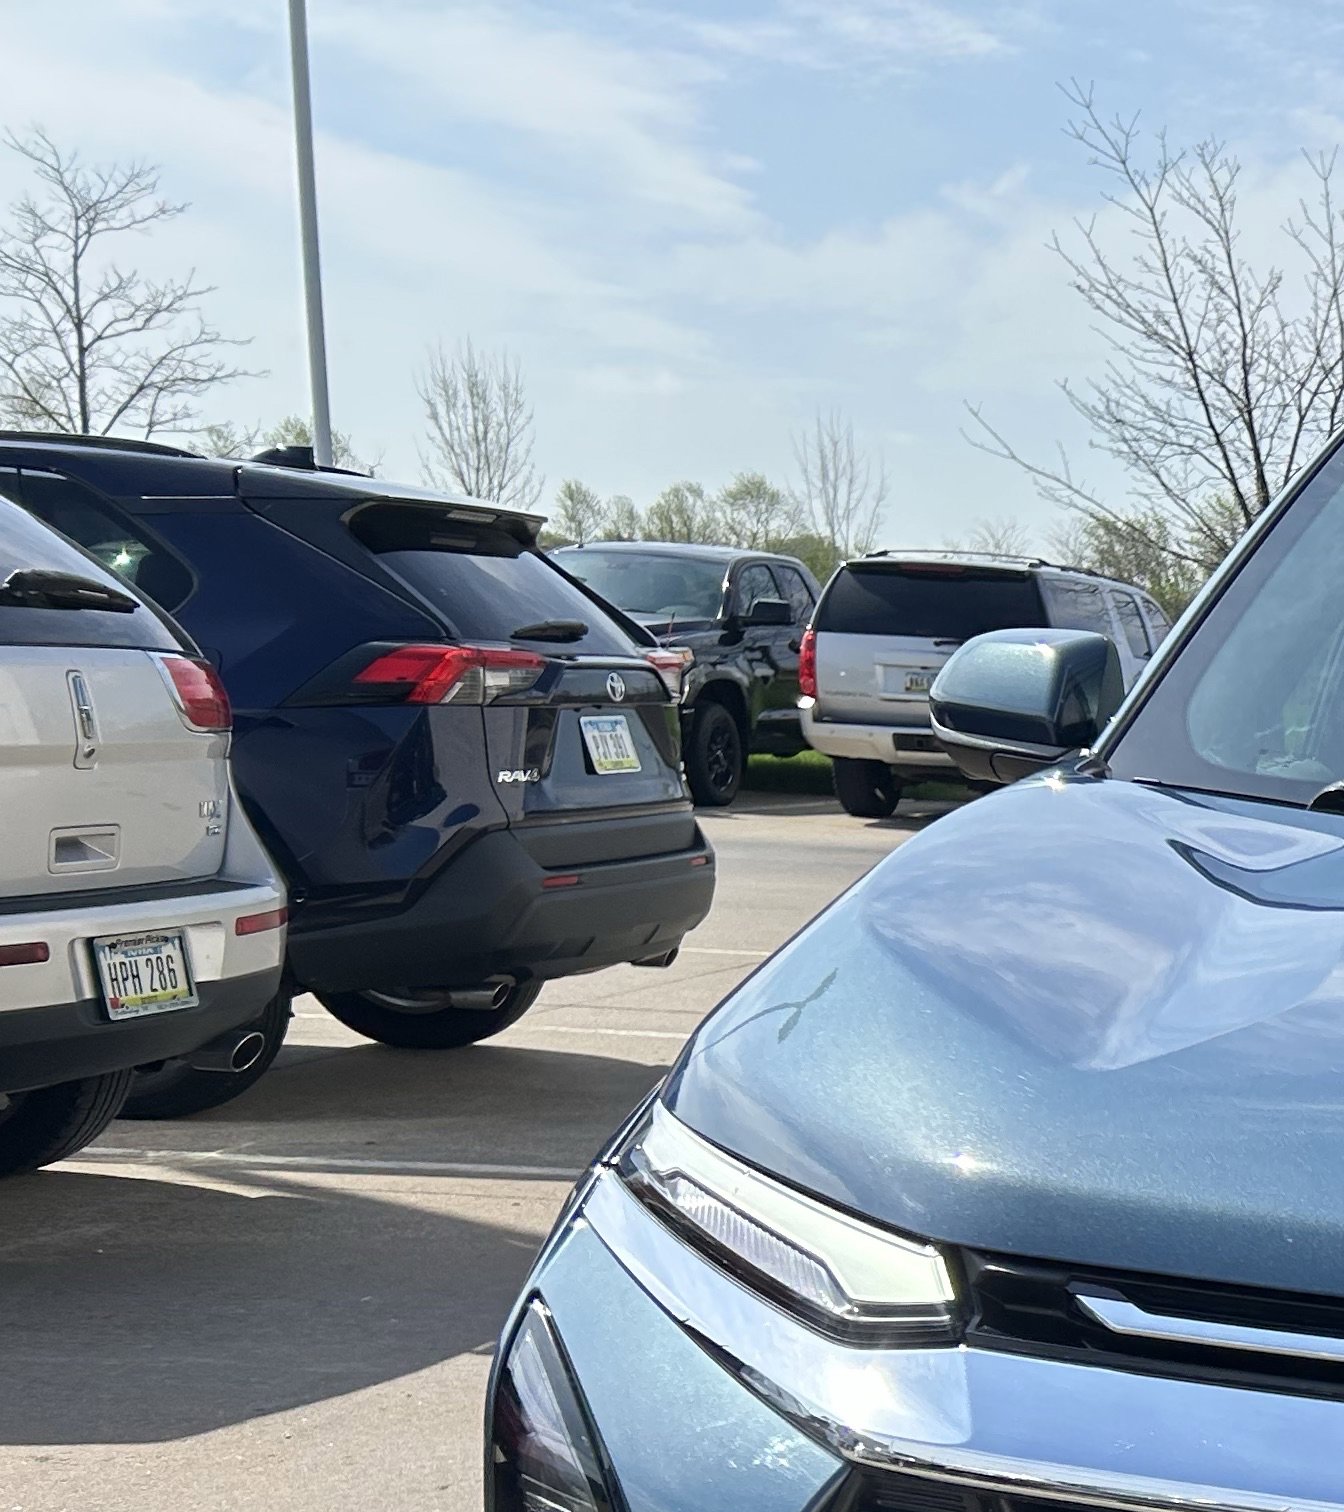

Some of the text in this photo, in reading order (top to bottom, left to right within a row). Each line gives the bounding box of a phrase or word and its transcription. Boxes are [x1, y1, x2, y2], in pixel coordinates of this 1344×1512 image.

[497, 768, 540, 783] RAV4
[107, 954, 178, 998] HPH 286
